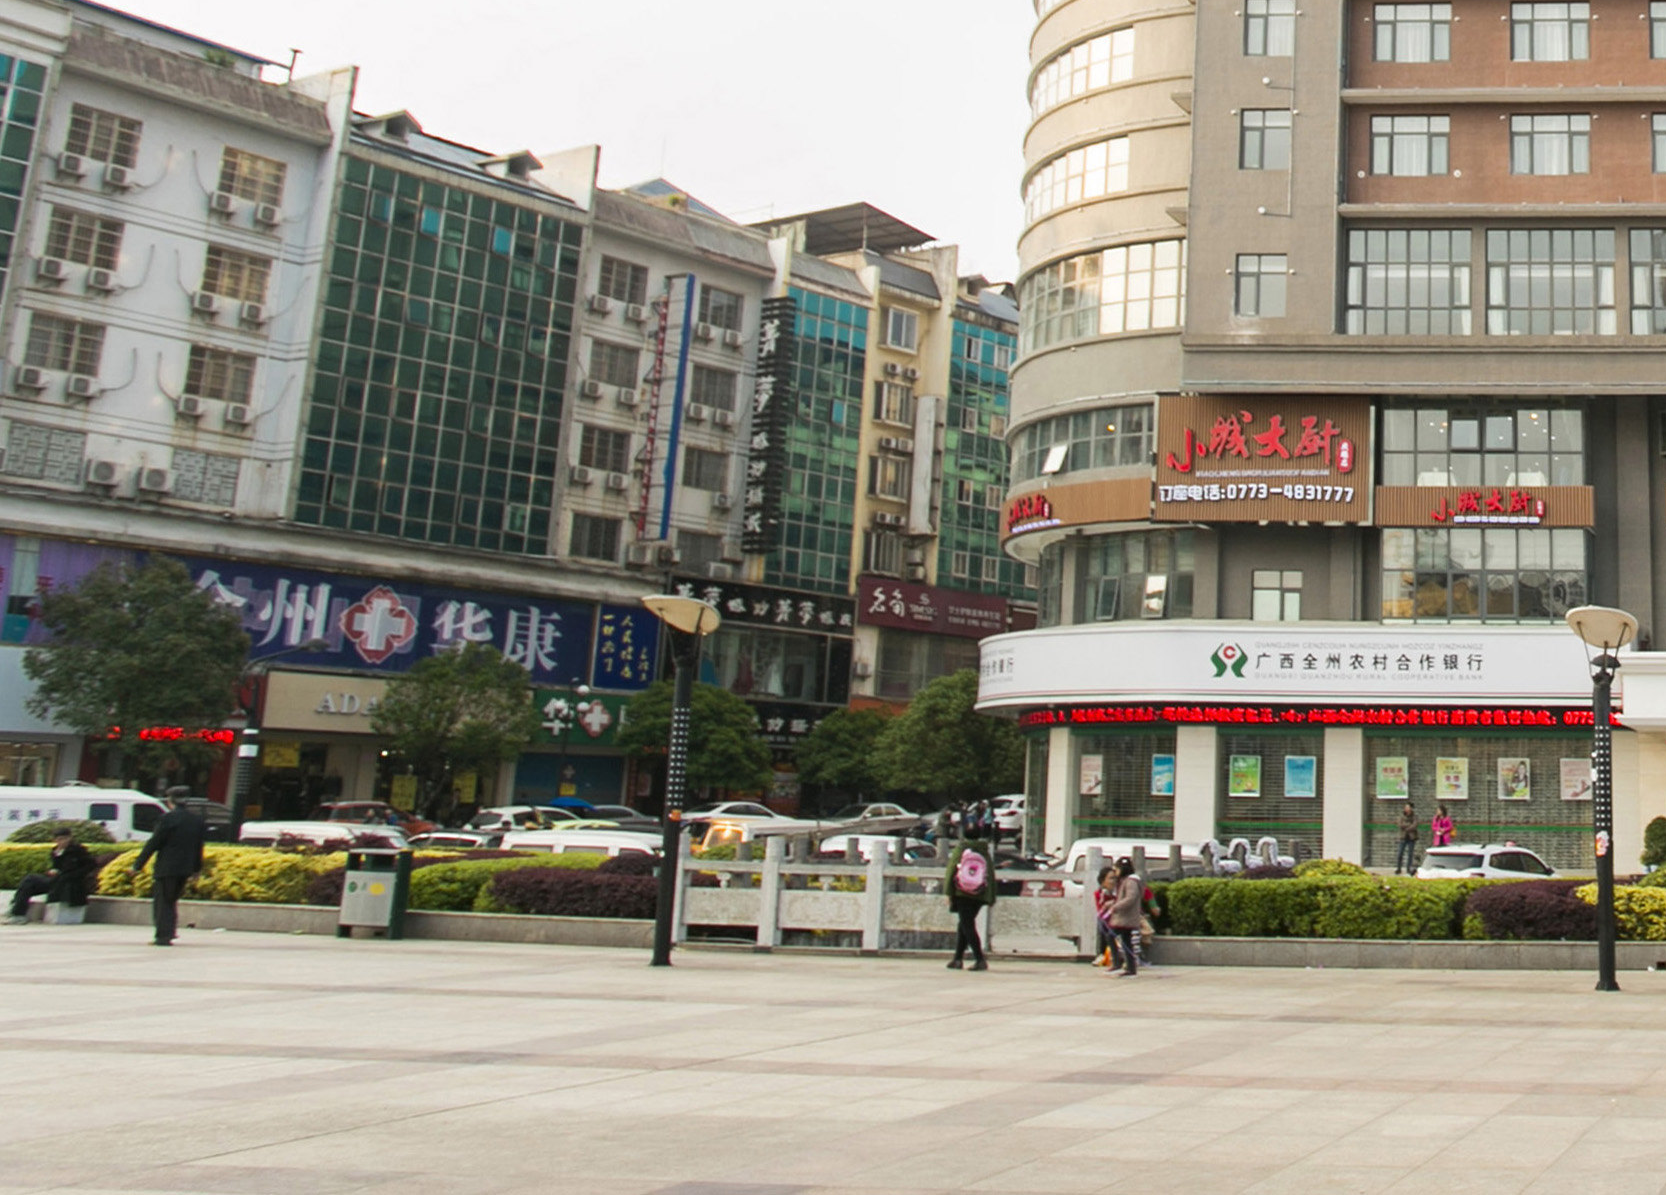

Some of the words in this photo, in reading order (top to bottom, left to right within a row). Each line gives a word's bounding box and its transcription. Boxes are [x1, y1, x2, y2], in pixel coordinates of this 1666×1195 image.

[1166, 411, 1341, 473] 小城大厨
[1431, 489, 1531, 521] 小城大厨
[1255, 653, 1484, 671] 广西全州农村合作银行
